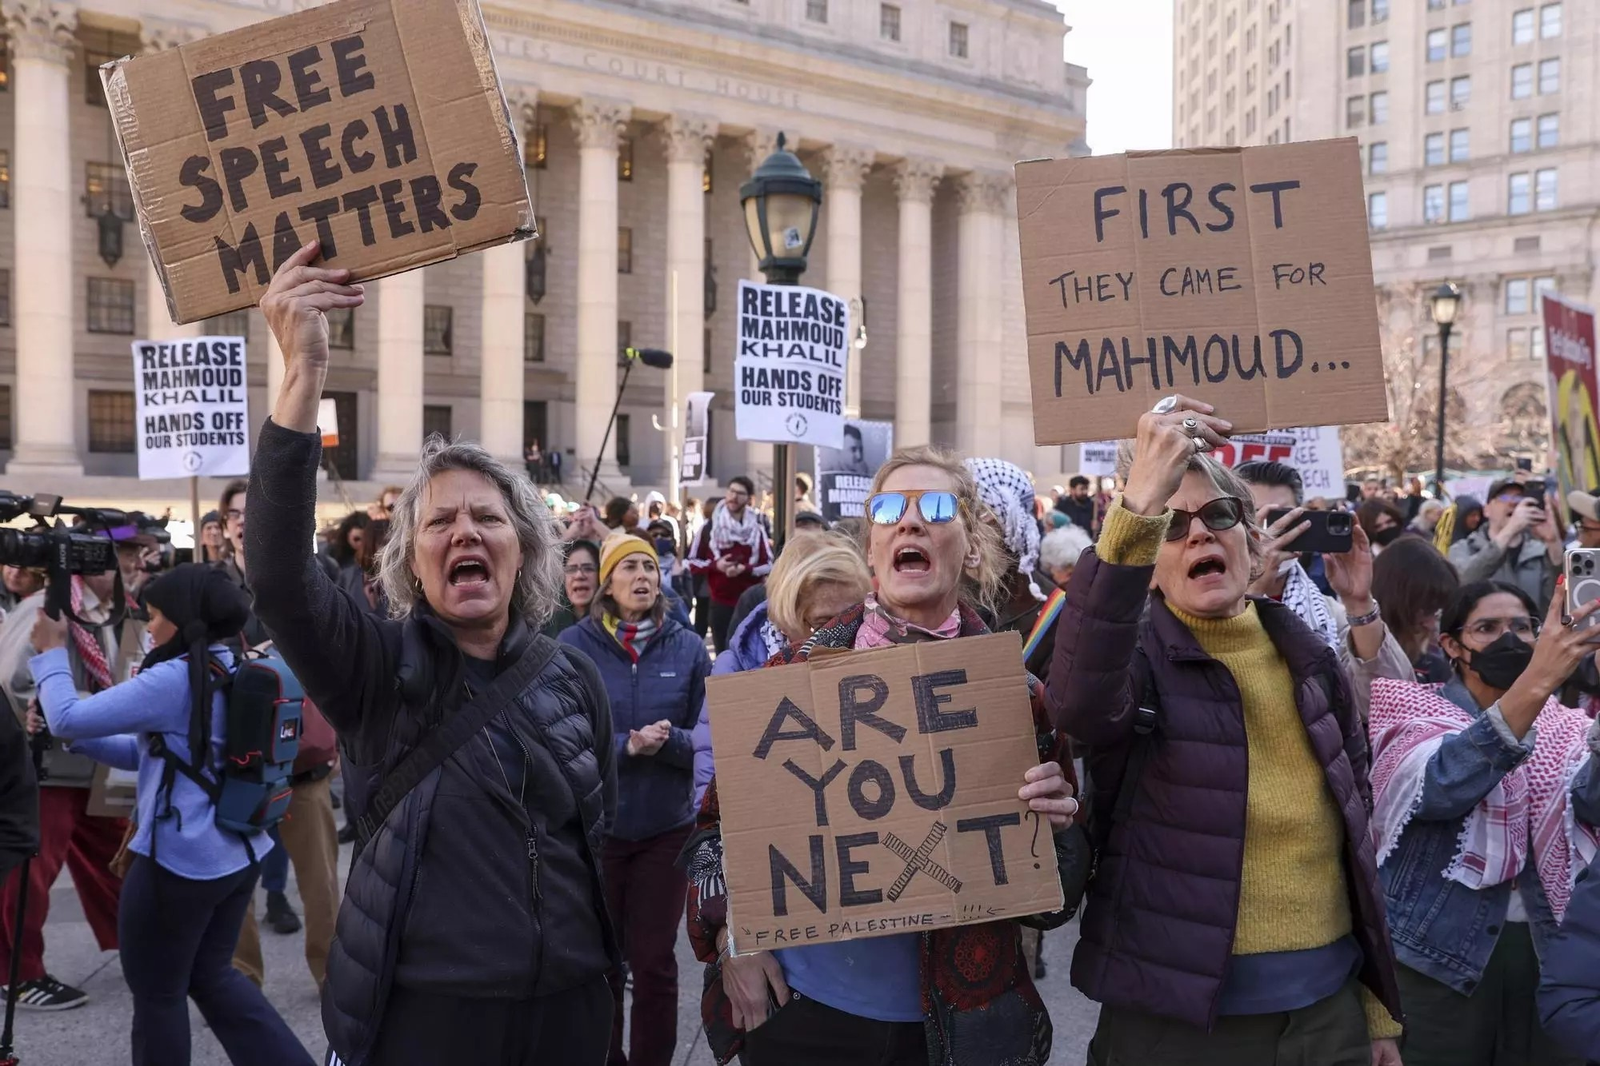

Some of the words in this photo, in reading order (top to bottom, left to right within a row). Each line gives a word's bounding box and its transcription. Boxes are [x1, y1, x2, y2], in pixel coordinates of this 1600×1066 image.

[191, 35, 375, 142] FREE
[583, 52, 685, 86] COURT
[715, 77, 801, 108] HOUSE
[179, 104, 416, 223] SPEECH
[213, 162, 482, 294] MATTERS
[1094, 180, 1300, 242] FIRST
[1049, 270, 1133, 308] THEY
[1159, 267, 1242, 296] CAME
[1272, 262, 1326, 290] FOR
[742, 286, 845, 328] RELEASE
[742, 316, 843, 350] MAHMOUD
[141, 342, 242, 369] RELEASE
[741, 340, 842, 368] KHALIL
[1054, 328, 1350, 397] MAHMOUD...
[143, 368, 242, 390] MAHMOUD
[144, 389, 243, 406] KHALIL
[742, 366, 812, 392] HANDS
[818, 374, 842, 398] OFF
[741, 389, 772, 406] OUR
[778, 391, 842, 415] STUDENTS
[145, 412, 205, 434] HANDS
[212, 412, 244, 430] OFF
[146, 435, 172, 449] OUR
[176, 432, 245, 448] STUDENTS
[752, 669, 978, 760] ARE
[782, 748, 956, 827] YOU
[756, 926, 819, 945] FREE
[828, 913, 934, 936] PALESTINE
